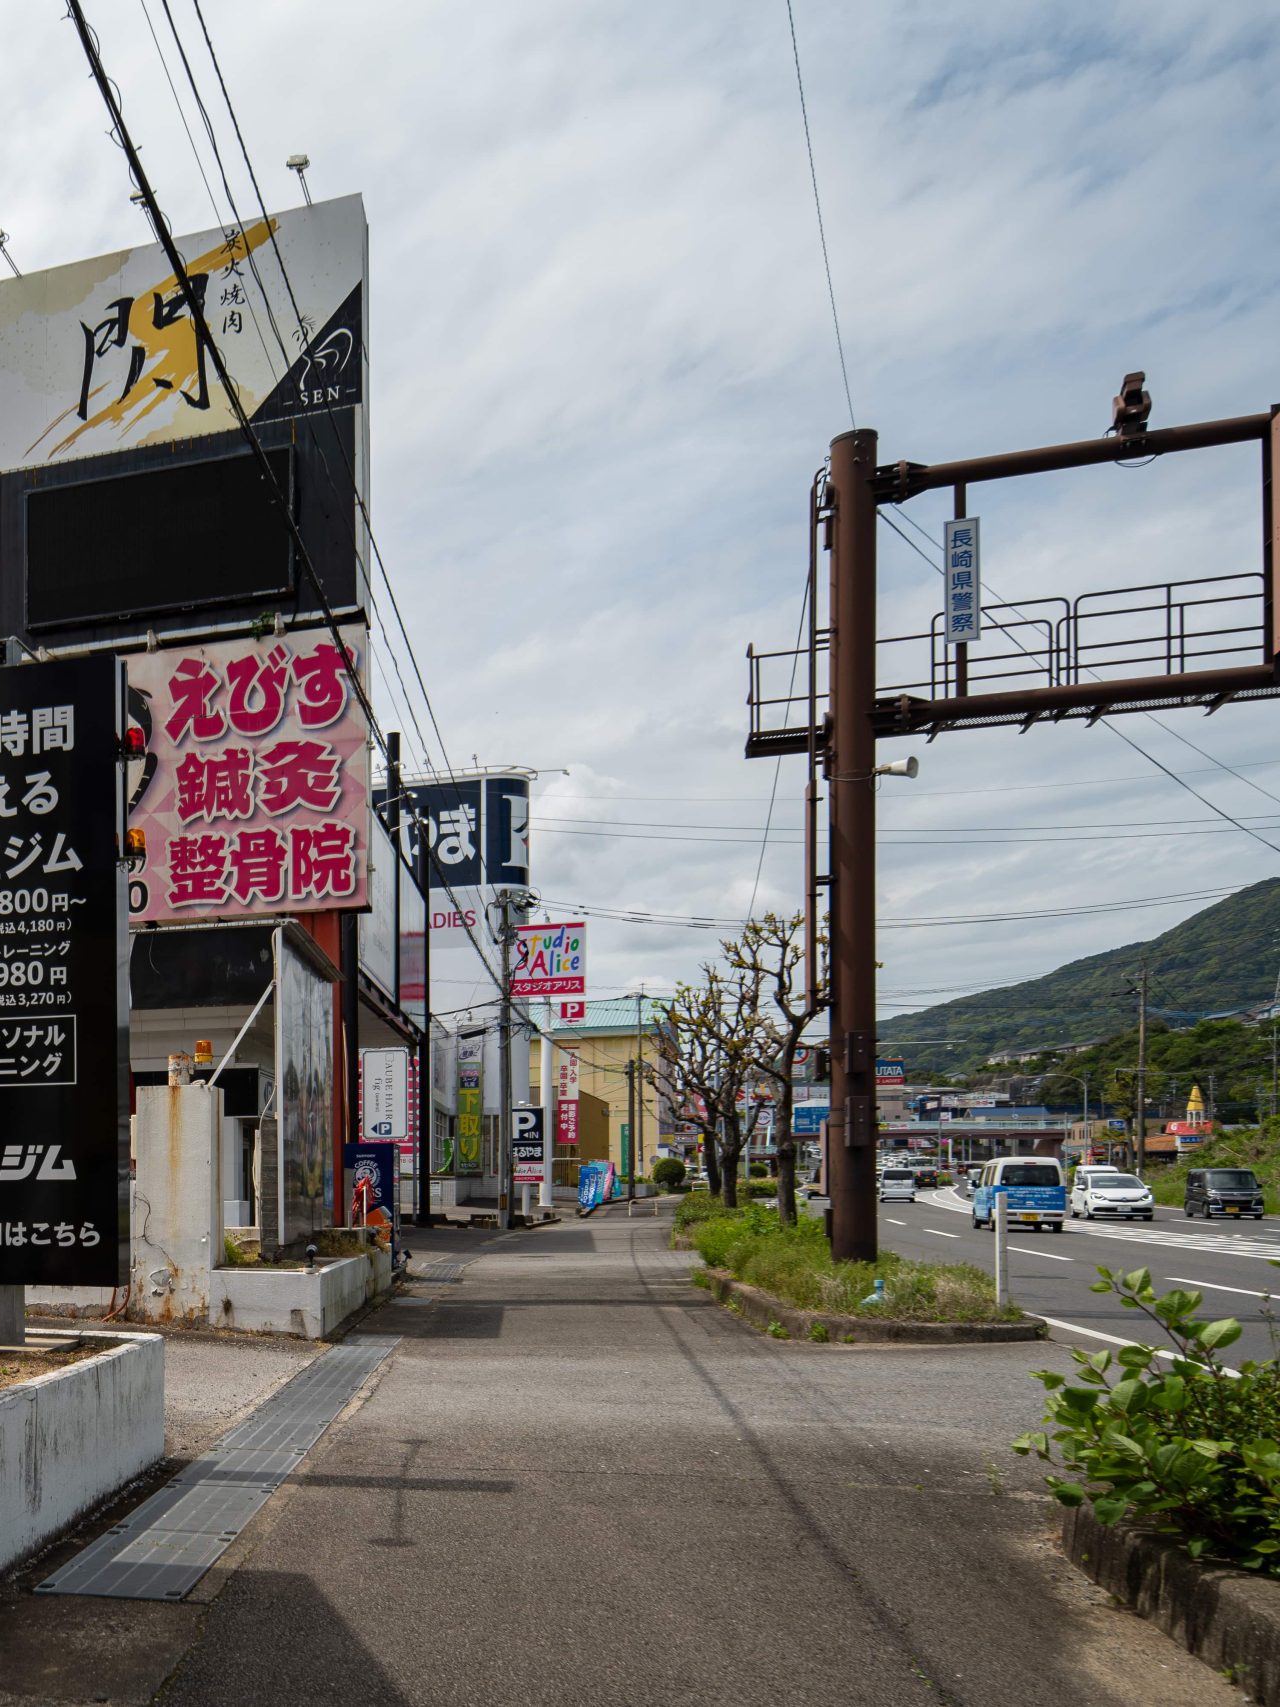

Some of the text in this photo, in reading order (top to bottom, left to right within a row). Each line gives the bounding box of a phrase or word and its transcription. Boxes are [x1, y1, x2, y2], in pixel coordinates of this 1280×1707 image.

[220, 229, 245, 334] 炭火焼肉
[300, 385, 341, 407] SEN
[951, 528, 974, 633] 長崎県警察
[165, 643, 355, 745] えびす
[176, 741, 343, 824] 鍼灸
[166, 822, 355, 906] 整骨院
[429, 909, 477, 929] DIES
[517, 926, 580, 971] Studio
[529, 950, 580, 977] Alice
[513, 980, 581, 993] スタジオアリス
[567, 1003, 580, 1018] P
[385, 1062, 393, 1120] AUBE HAIR
[459, 1089, 480, 1161] 下取り
[512, 1111, 536, 1139] P
[529, 1131, 539, 1139] IN
[355, 1160, 379, 1169] COFFEE
